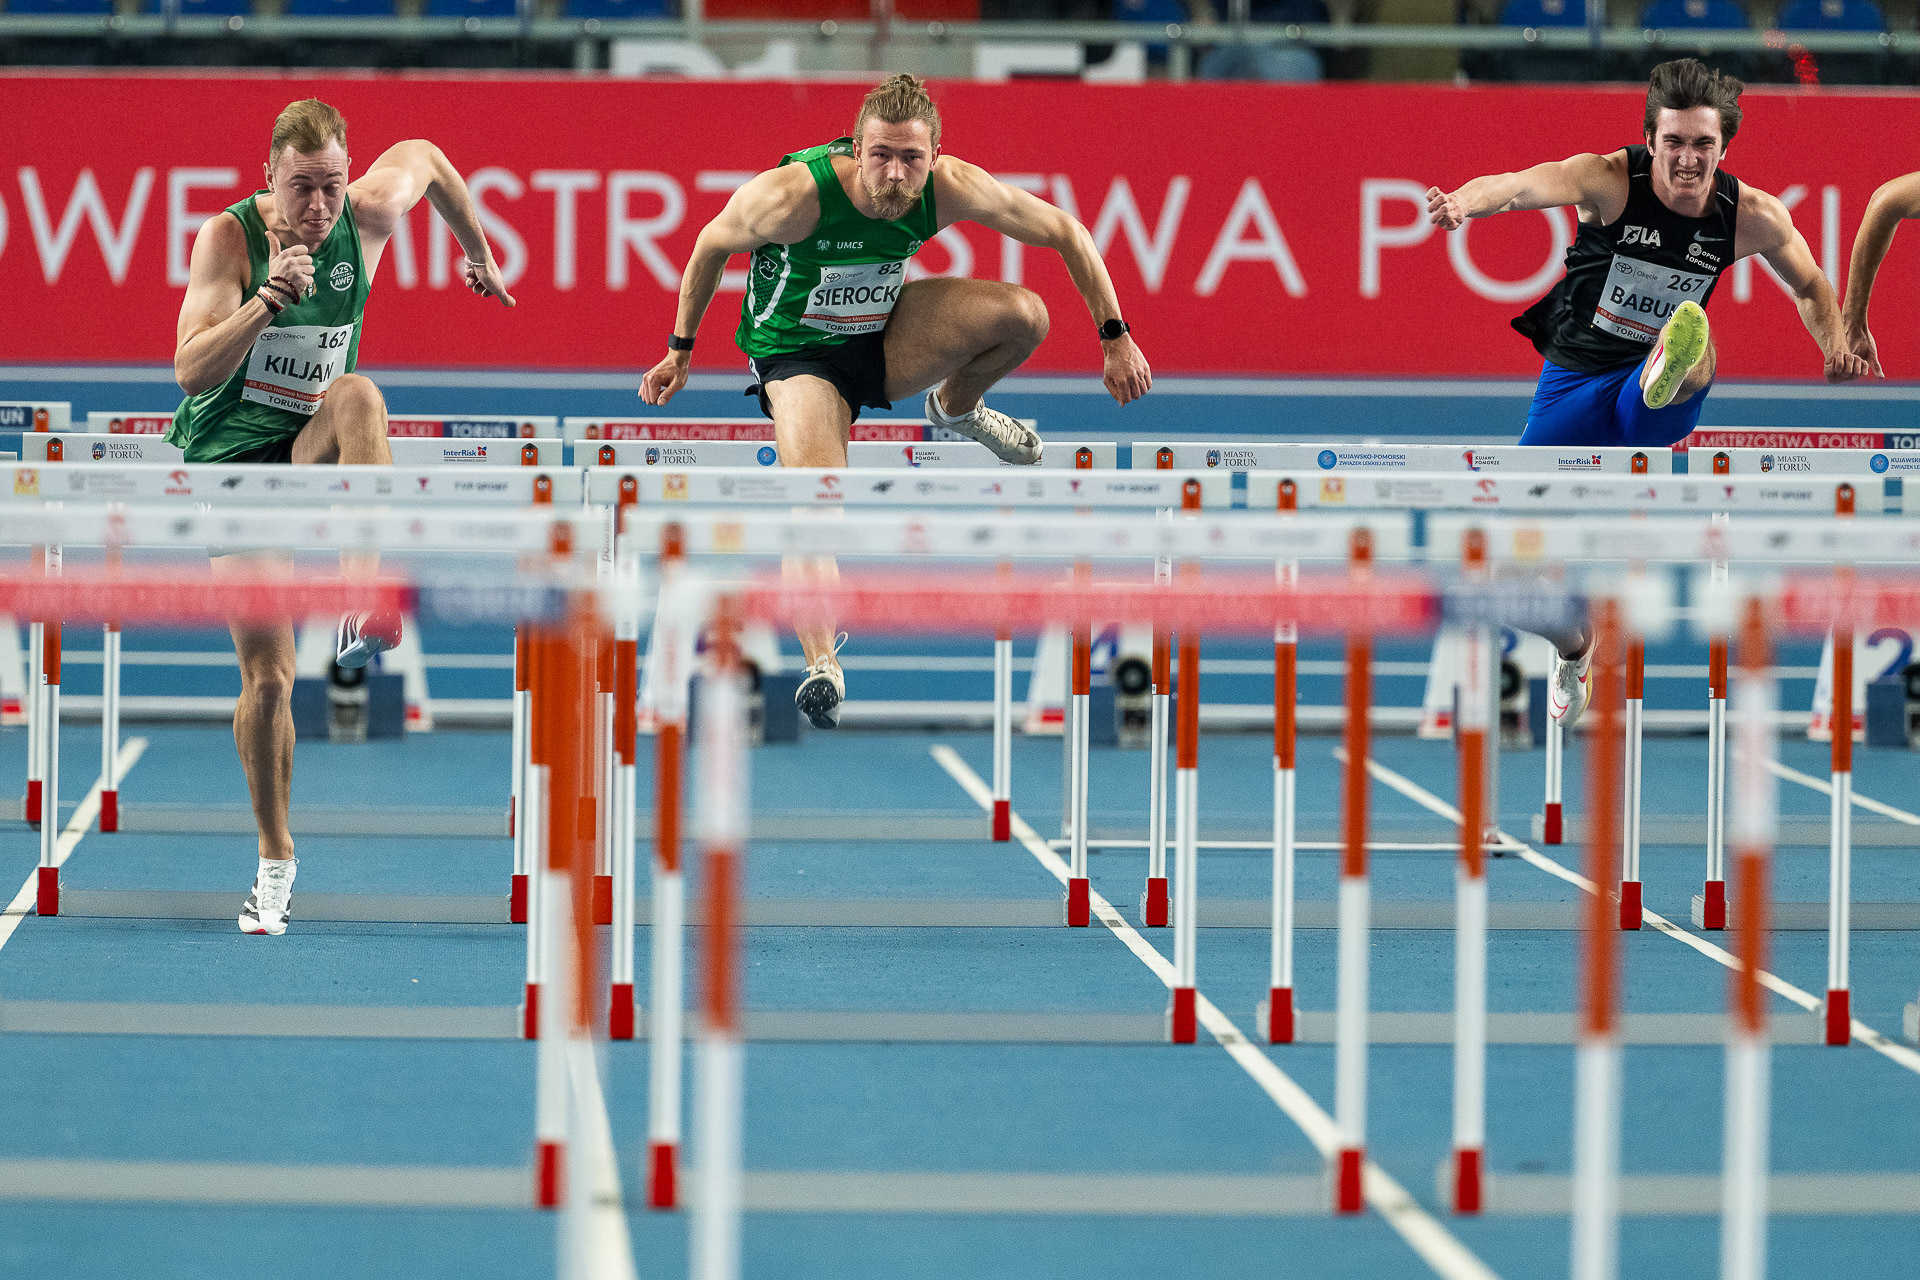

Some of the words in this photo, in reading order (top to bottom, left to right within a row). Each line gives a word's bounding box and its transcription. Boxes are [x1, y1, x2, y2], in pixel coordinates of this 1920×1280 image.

[0, 165, 240, 288] WE
[836, 241, 864, 249] UMCS
[1701, 251, 1721, 263] OPOLE
[335, 265, 349, 275] AZS
[877, 262, 903, 276] 82
[1689, 256, 1718, 273] OPOLSKIE
[1636, 270, 1658, 281] Okęcie
[334, 276, 351, 287] AWF
[1666, 274, 1706, 293] 267
[825, 322, 857, 332] TORUŃ
[857, 323, 877, 332] 2025
[317, 330, 347, 349] 162
[1615, 326, 1647, 342] TORUŃ
[263, 354, 335, 383] KILJAN
[268, 395, 301, 410] TORUŃ
[388, 422, 435, 437] OLSKI
[1700, 433, 1814, 449] MISTRZOSTWA
[1818, 434, 1875, 449] POLSKI
[109, 443, 139, 451] MIASTO
[662, 448, 693, 456] MIASTO
[109, 449, 143, 459] TORUŃ
[443, 449, 477, 457] InterRisk
[662, 453, 697, 464] TORUŃ
[1223, 451, 1253, 459] MIASTO
[1223, 456, 1257, 467] TORUŃ
[1777, 455, 1807, 463] MIASTO
[1777, 460, 1812, 472] TORUŃ
